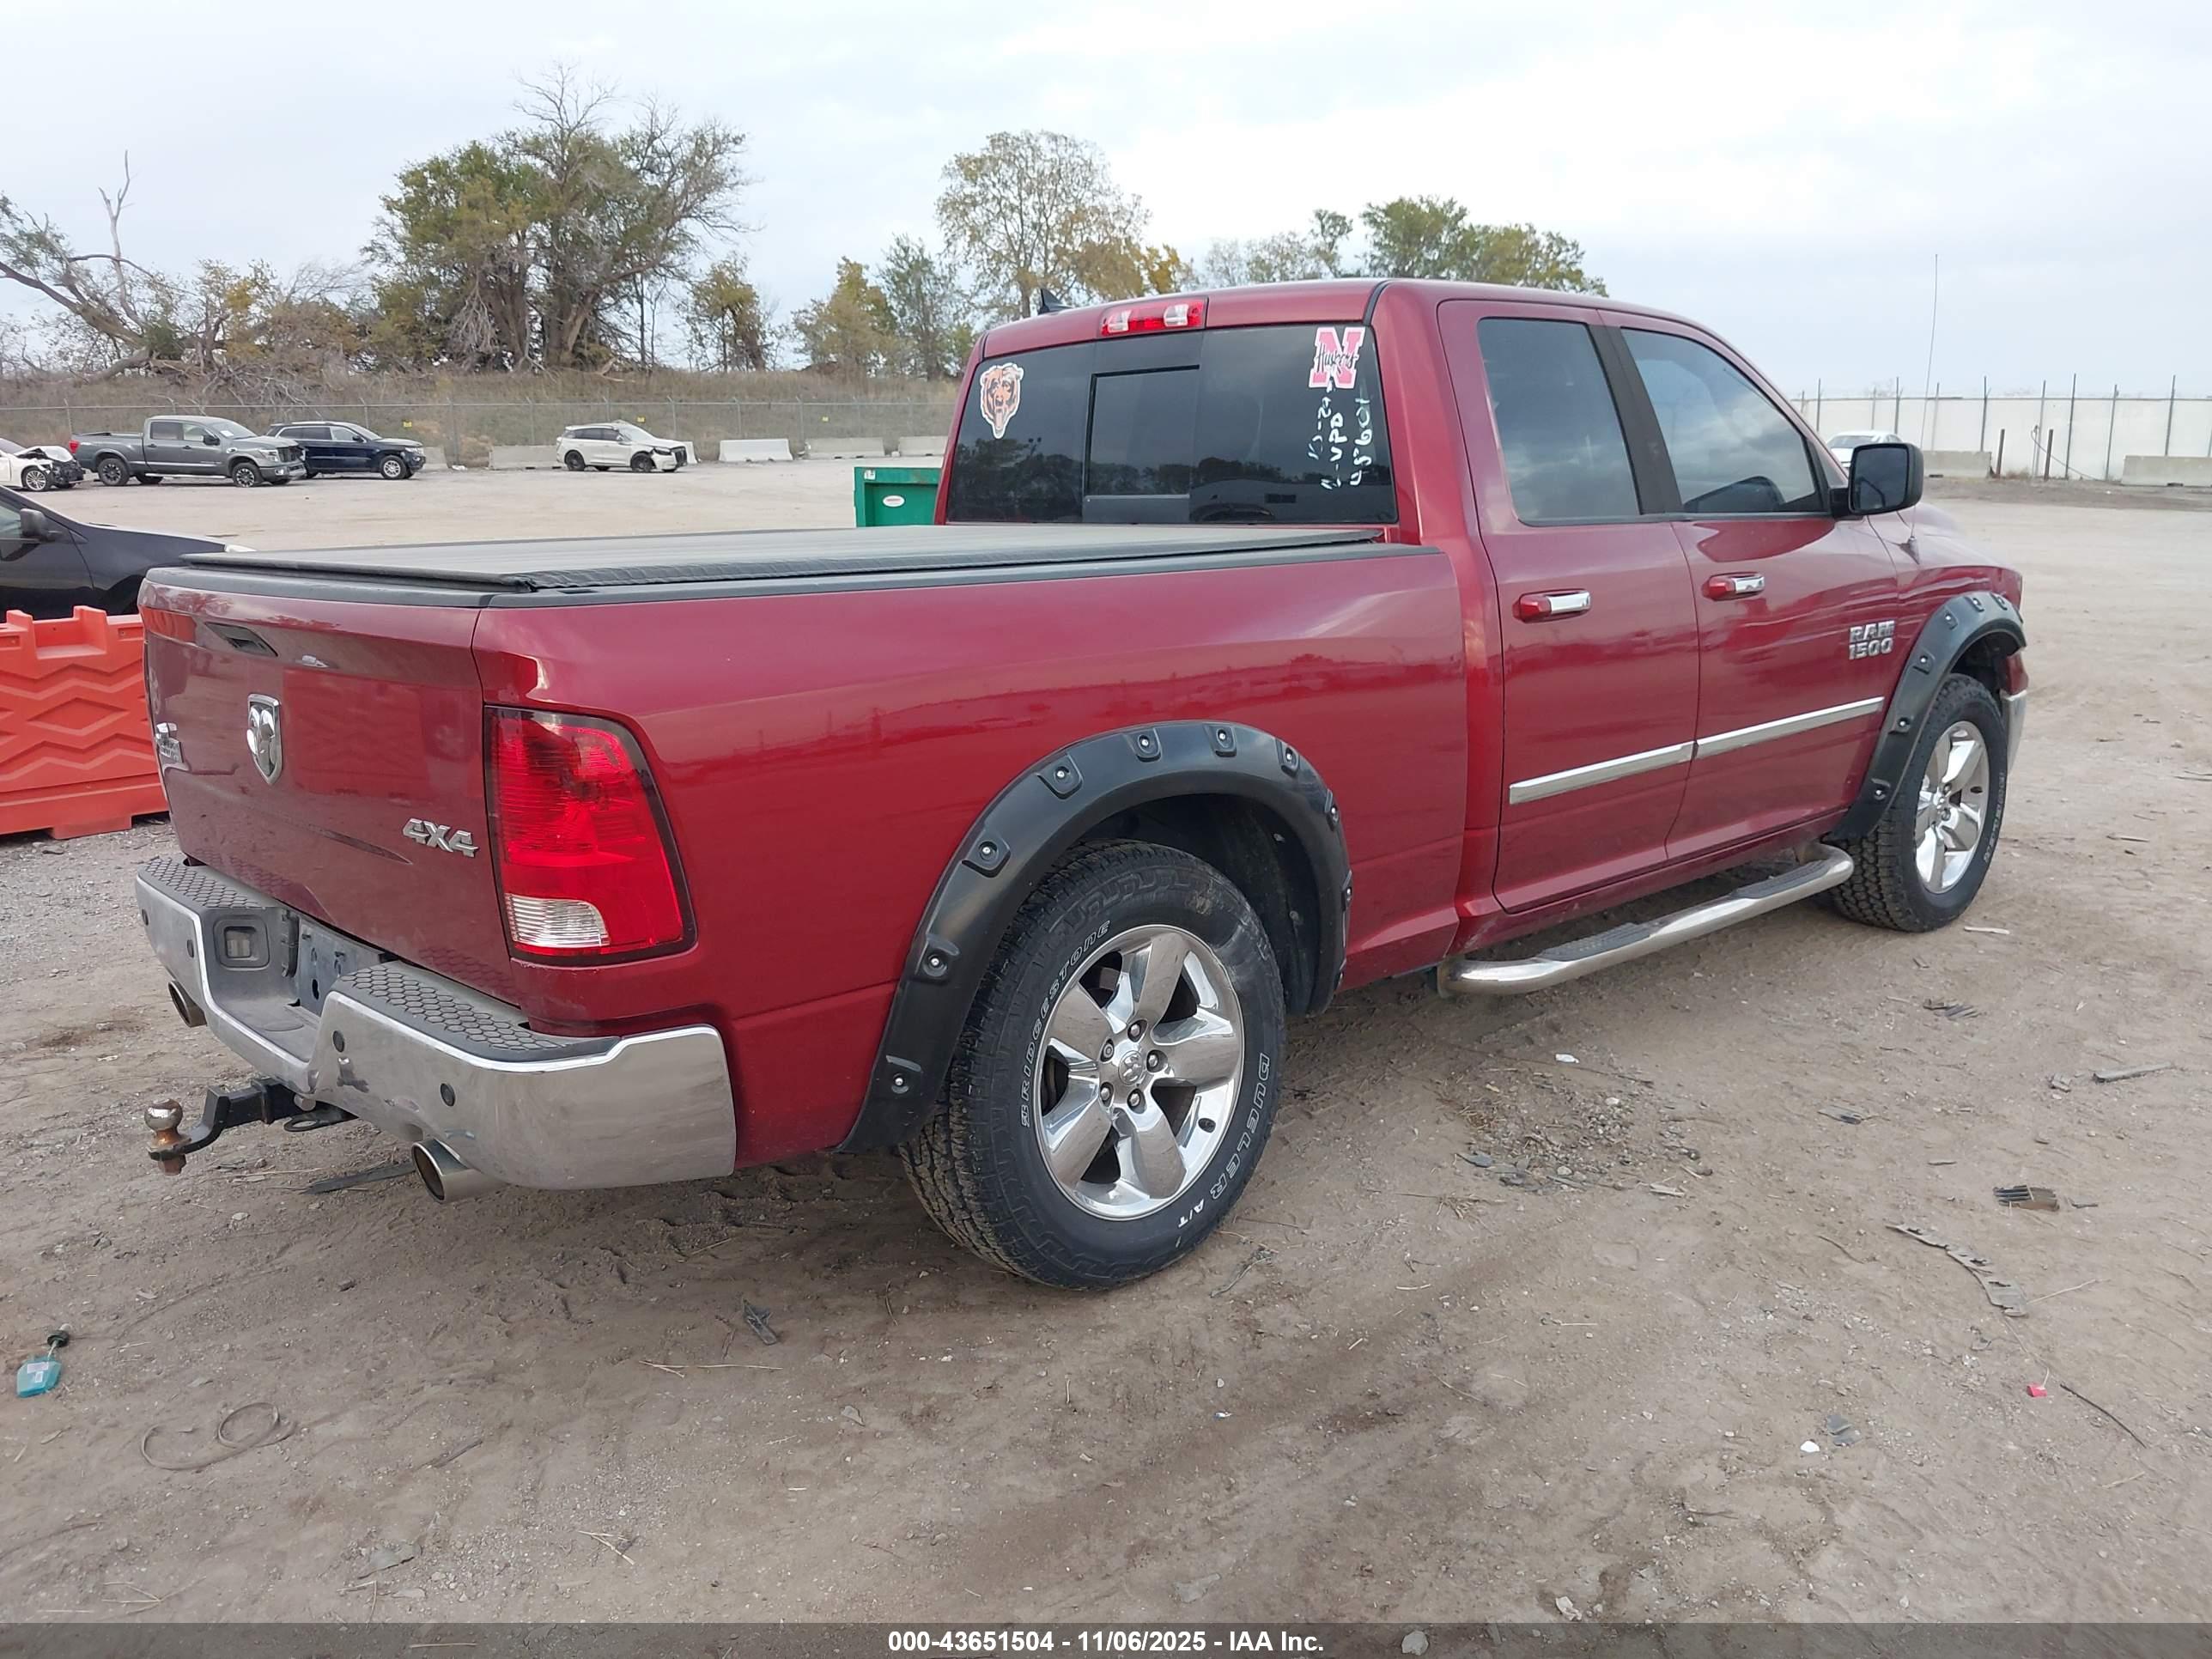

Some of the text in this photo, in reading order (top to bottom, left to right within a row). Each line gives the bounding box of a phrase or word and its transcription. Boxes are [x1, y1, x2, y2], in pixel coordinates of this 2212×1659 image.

[1309, 326, 1366, 389] N
[1848, 637, 1894, 660] 1500
[1849, 620, 1895, 642] RAM
[1021, 920, 1111, 1127] BRIDGESTONE
[1177, 1052, 1270, 1228] DUELER A/T
